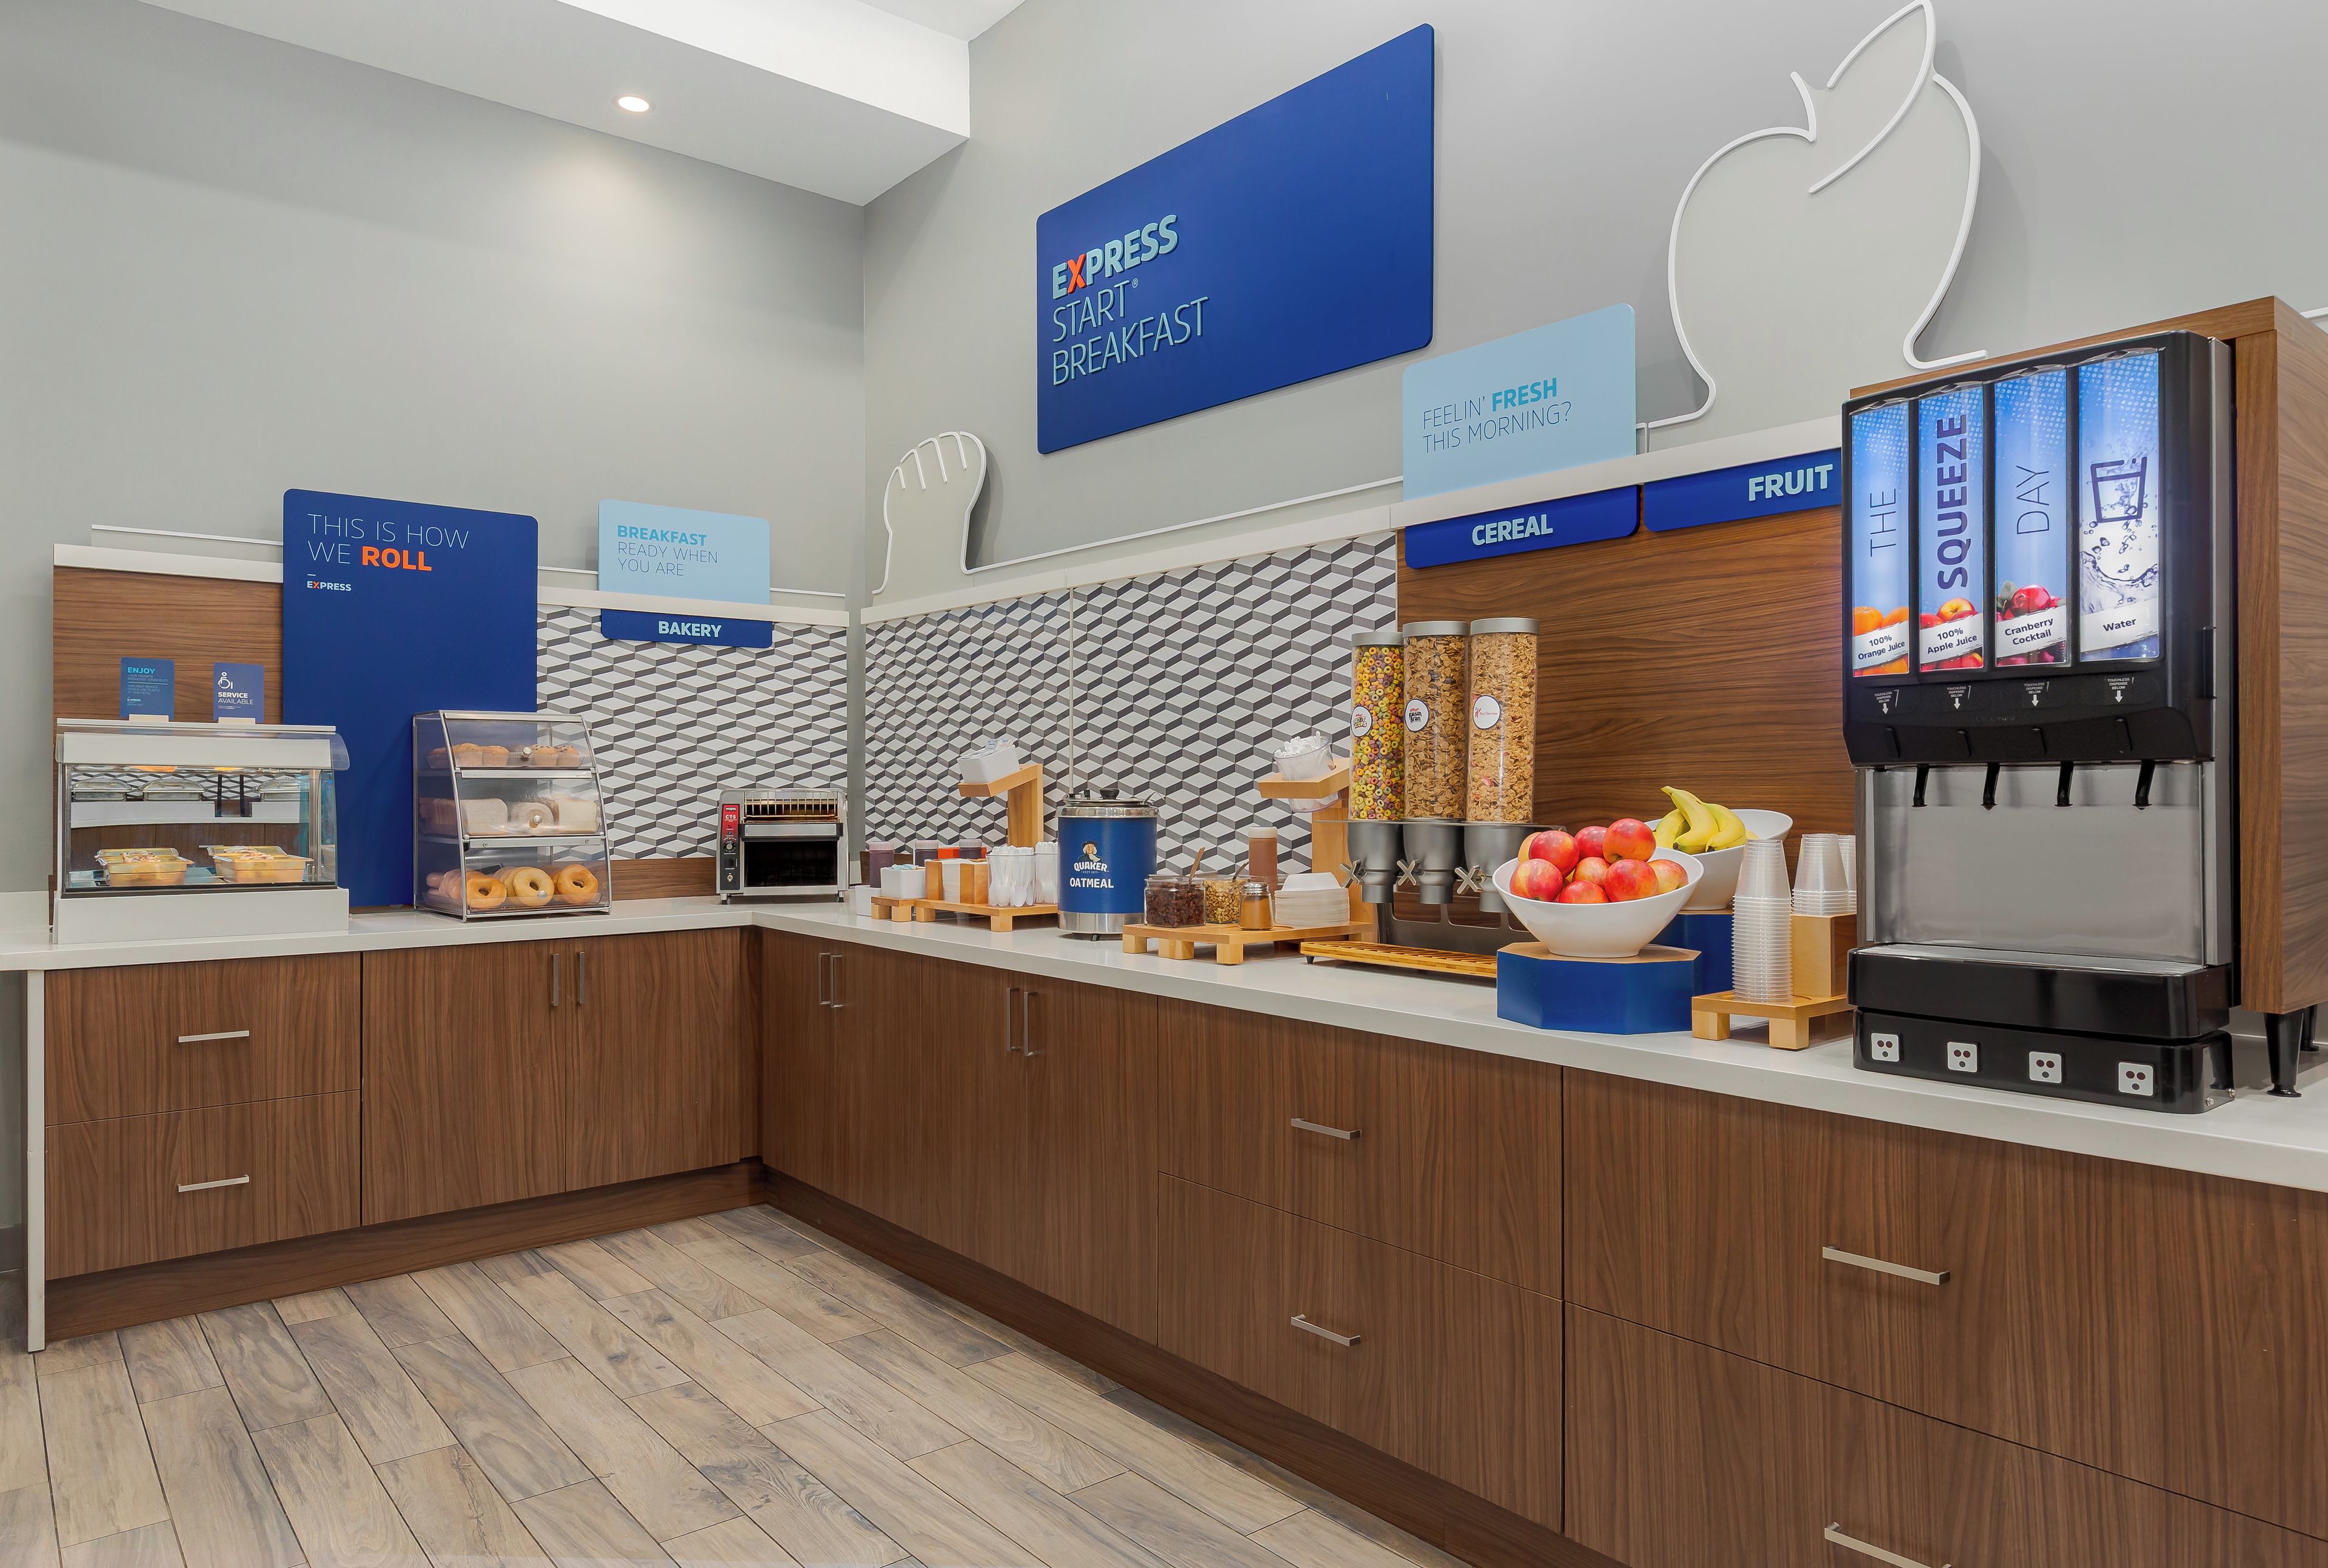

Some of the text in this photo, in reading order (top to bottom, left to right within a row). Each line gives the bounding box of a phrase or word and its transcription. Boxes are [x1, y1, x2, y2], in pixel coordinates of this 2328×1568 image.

[1052, 214, 1178, 299] EXPRESS
[1052, 296, 1208, 385] BREAKFAST
[1492, 377, 1557, 412] FRESH
[1422, 401, 1571, 453] THIS MORNING?
[1748, 464, 1833, 501] FRUIT
[1936, 413, 1972, 590] SQUEEZE
[2016, 465, 2050, 535] DAY
[307, 513, 469, 549] THIS IS HOW
[1471, 513, 1554, 546] CEREAL
[1869, 488, 1896, 557] THE
[617, 524, 707, 547] BREAKFAST
[307, 540, 432, 572] WE ROLL
[618, 541, 718, 564] READY WHEN
[617, 557, 684, 576] YOU ARE
[307, 580, 352, 592] EXPRESS
[658, 620, 723, 638] BAKERY
[1936, 627, 1964, 641] 100%
[2004, 617, 2054, 636] Cranberry
[2102, 618, 2136, 632] Water
[1868, 634, 1892, 647] 100%
[1927, 634, 1978, 655] Apple Juice
[2012, 629, 2052, 646] Cocktail
[1858, 640, 1905, 660] Orange Juice
[1074, 861, 1108, 872] QUAKER
[1069, 877, 1114, 889] OATMEAL
